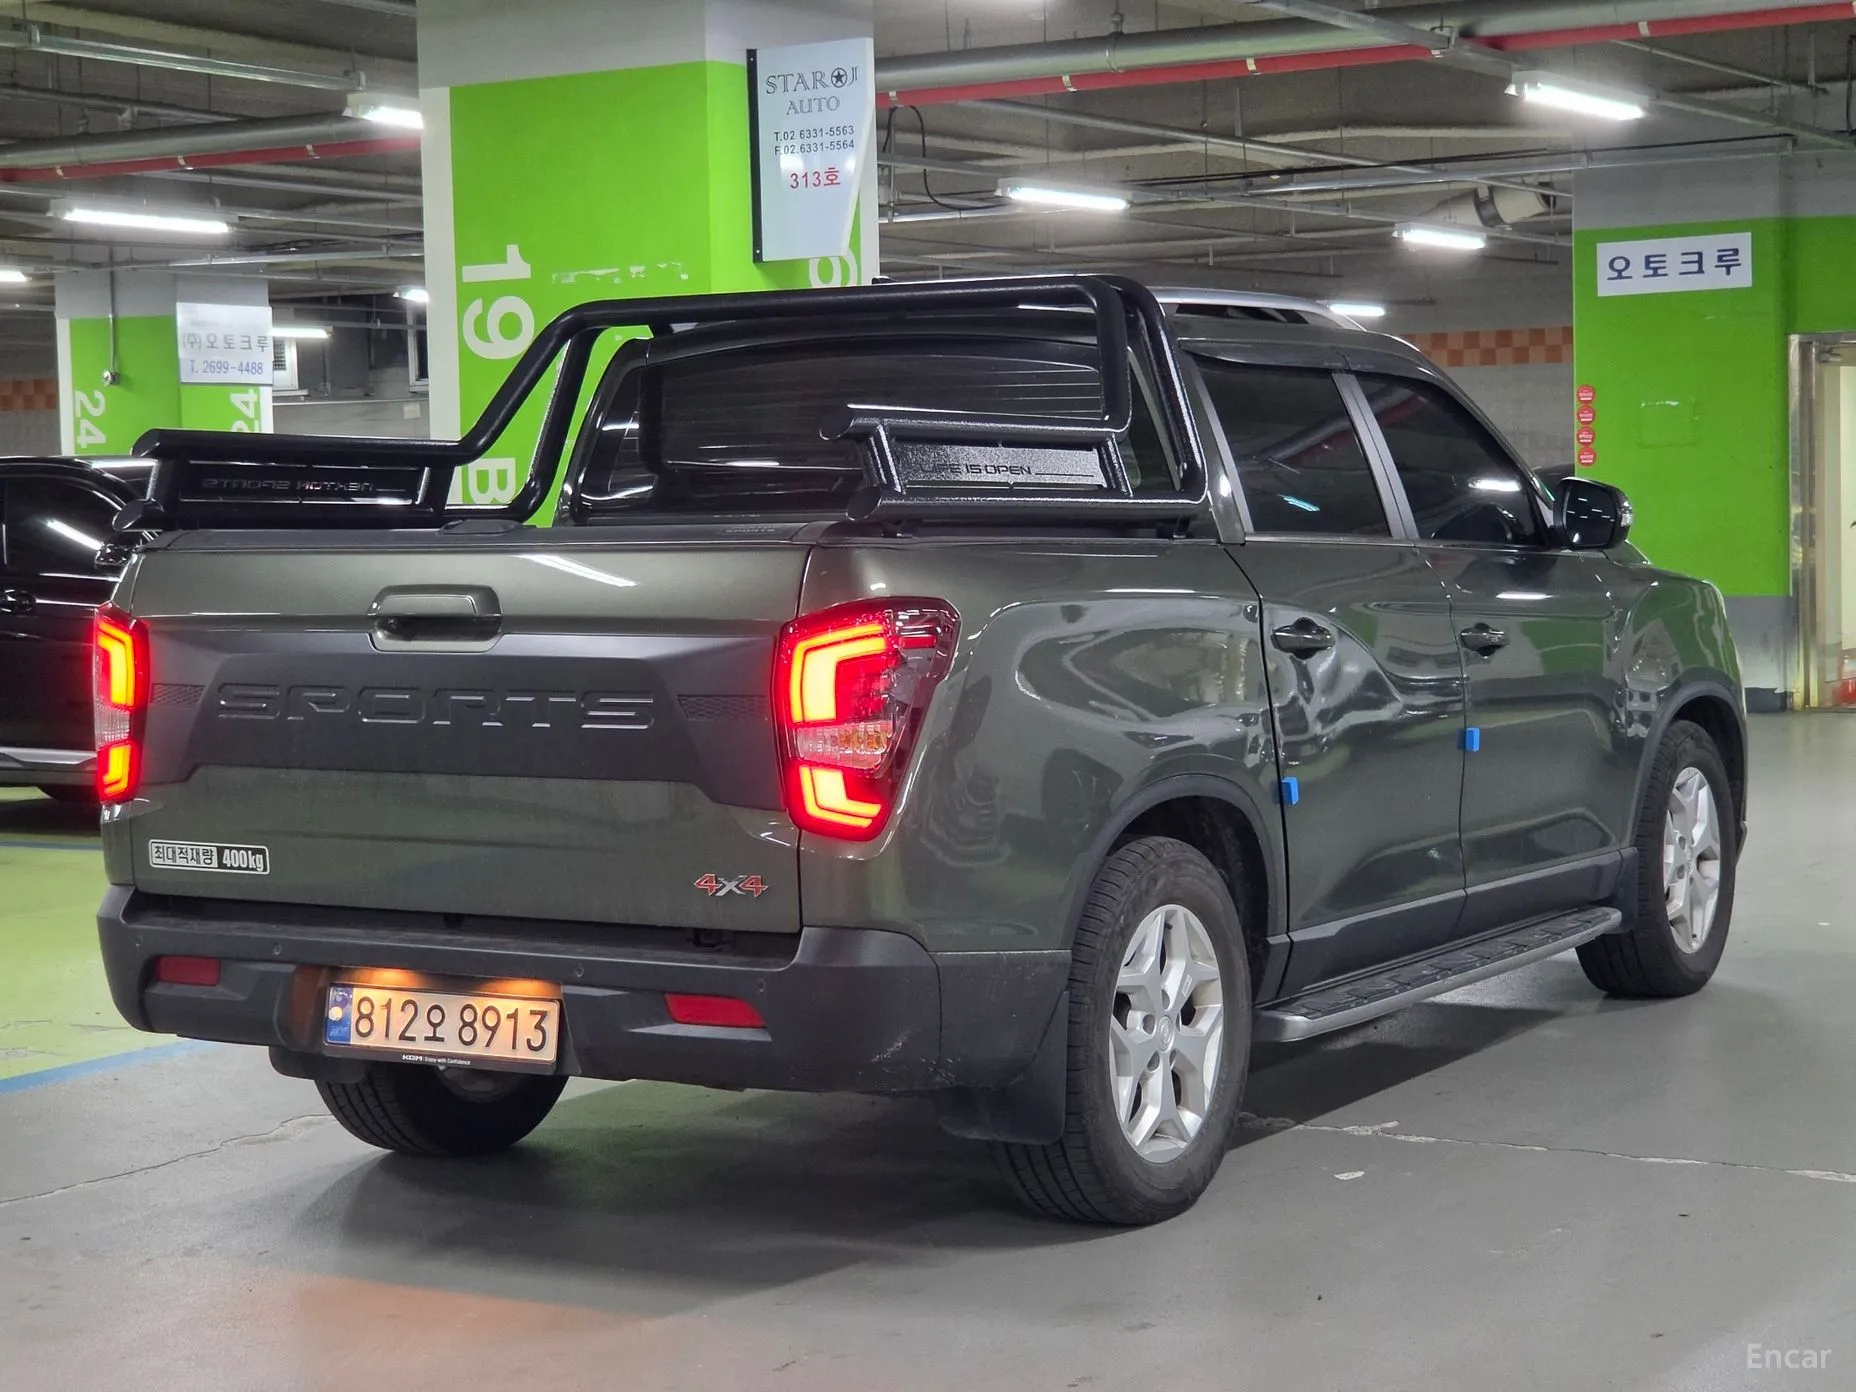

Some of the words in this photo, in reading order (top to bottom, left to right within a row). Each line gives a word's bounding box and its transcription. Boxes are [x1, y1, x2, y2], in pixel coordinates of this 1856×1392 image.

[786, 96, 840, 115] AUTO
[799, 125, 854, 139] 6331-5563
[790, 167, 841, 189] 313호
[1607, 248, 1741, 280] 오토크루
[462, 244, 535, 360] 19
[202, 360, 264, 375] 2699-4488
[75, 389, 107, 449] 24
[467, 457, 516, 504] B
[965, 463, 982, 474] IS
[984, 464, 1032, 475] OPEN
[217, 682, 655, 731] SPORTS
[154, 845, 214, 866] 최대적재량
[222, 848, 264, 872] 400kg
[457, 1003, 549, 1052] 8913
